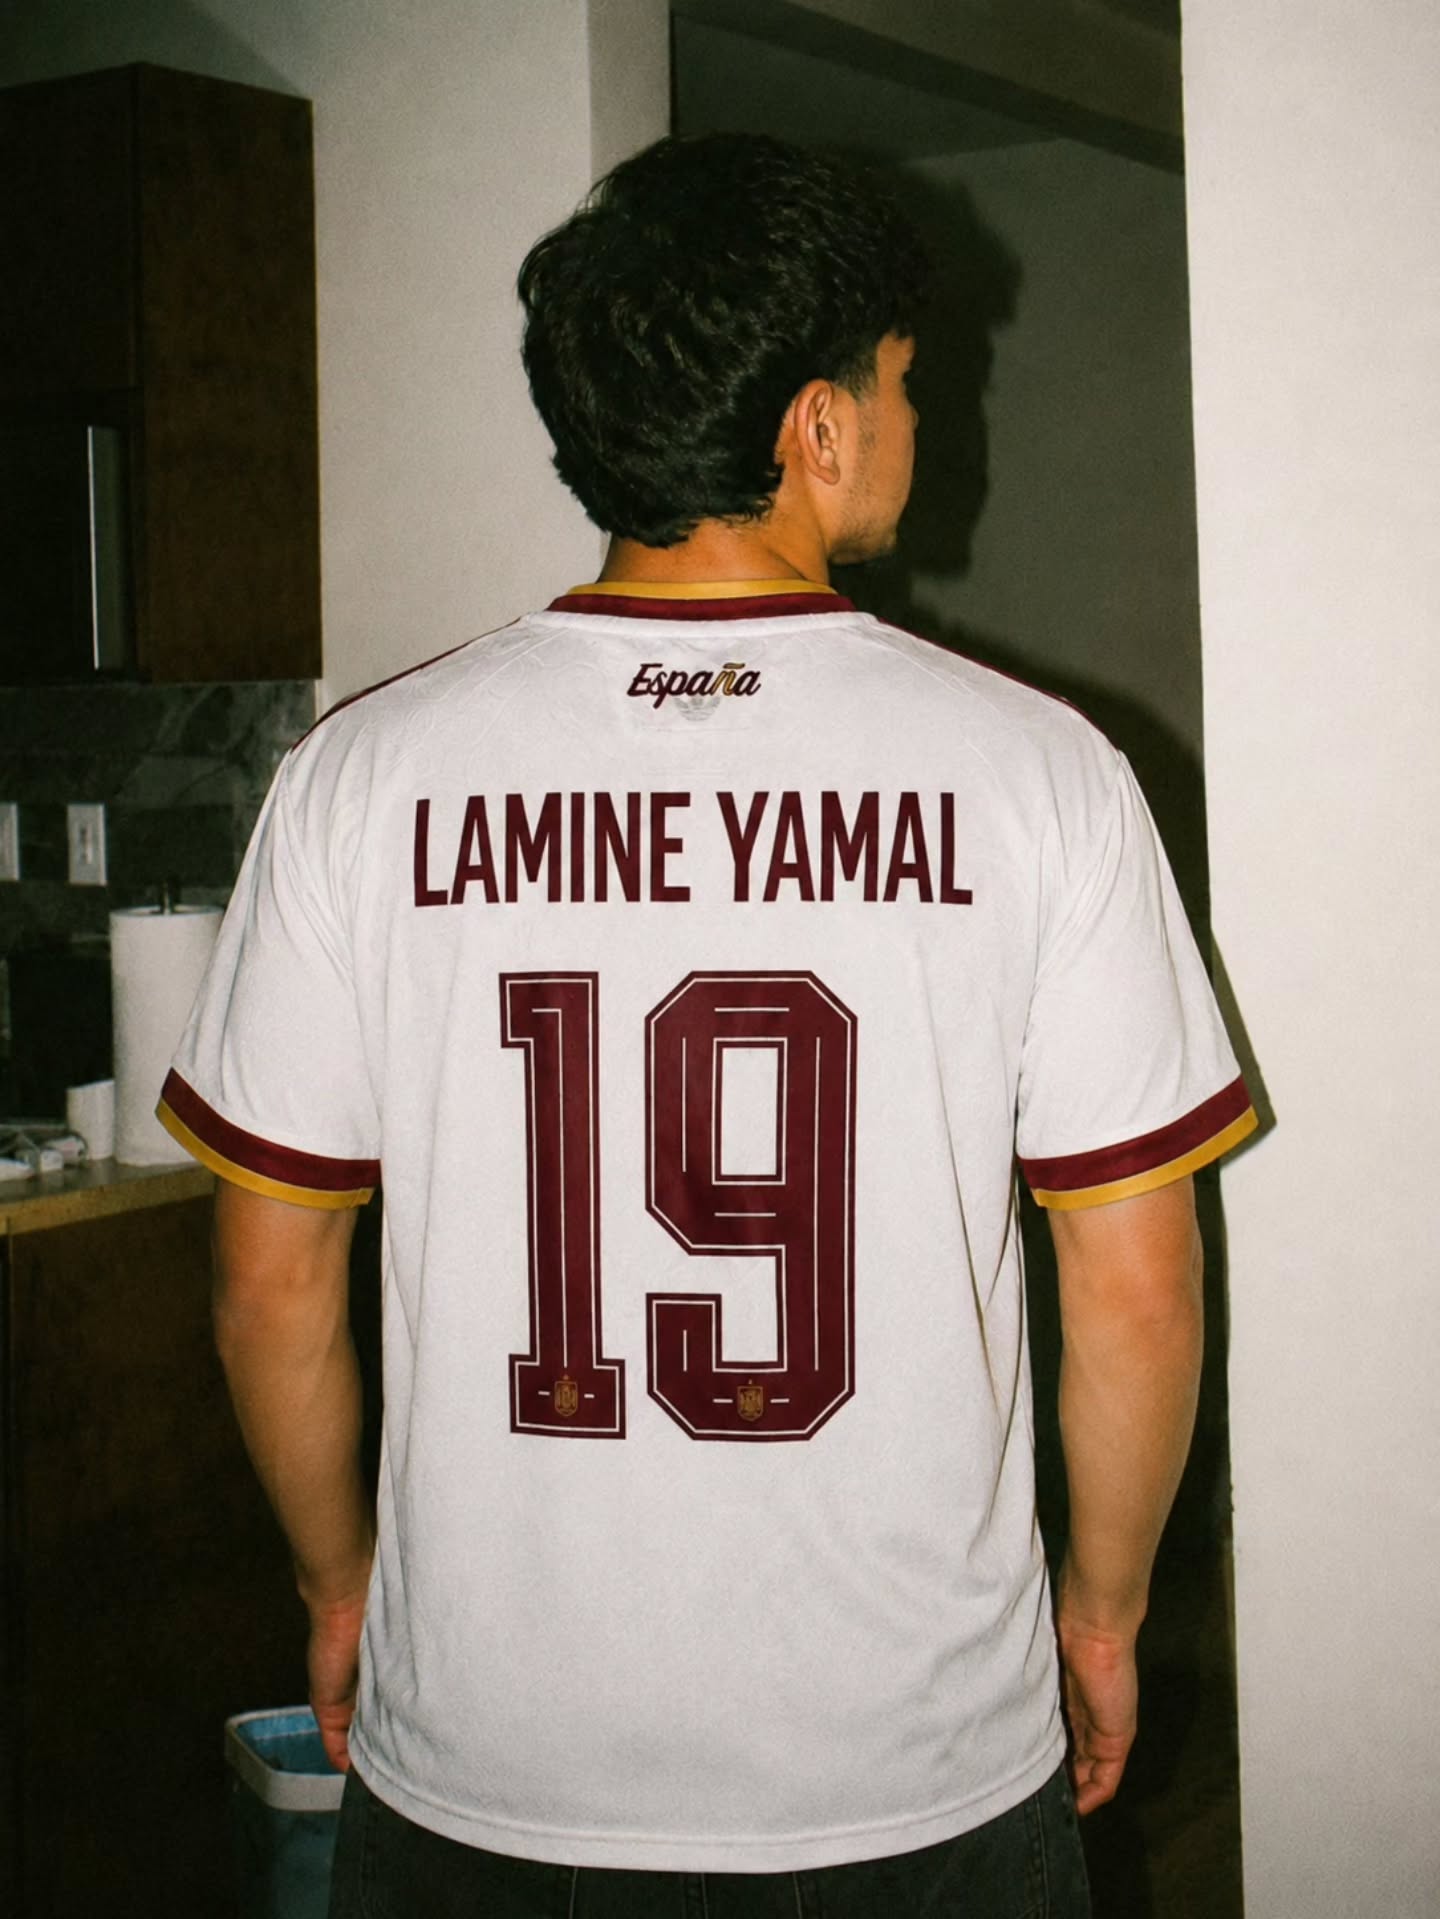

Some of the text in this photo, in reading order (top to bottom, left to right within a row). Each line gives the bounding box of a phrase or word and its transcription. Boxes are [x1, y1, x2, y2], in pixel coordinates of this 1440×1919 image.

[627, 662, 762, 709] España
[413, 790, 973, 907] LAMINE YAMAL
[498, 970, 858, 1442] 19
